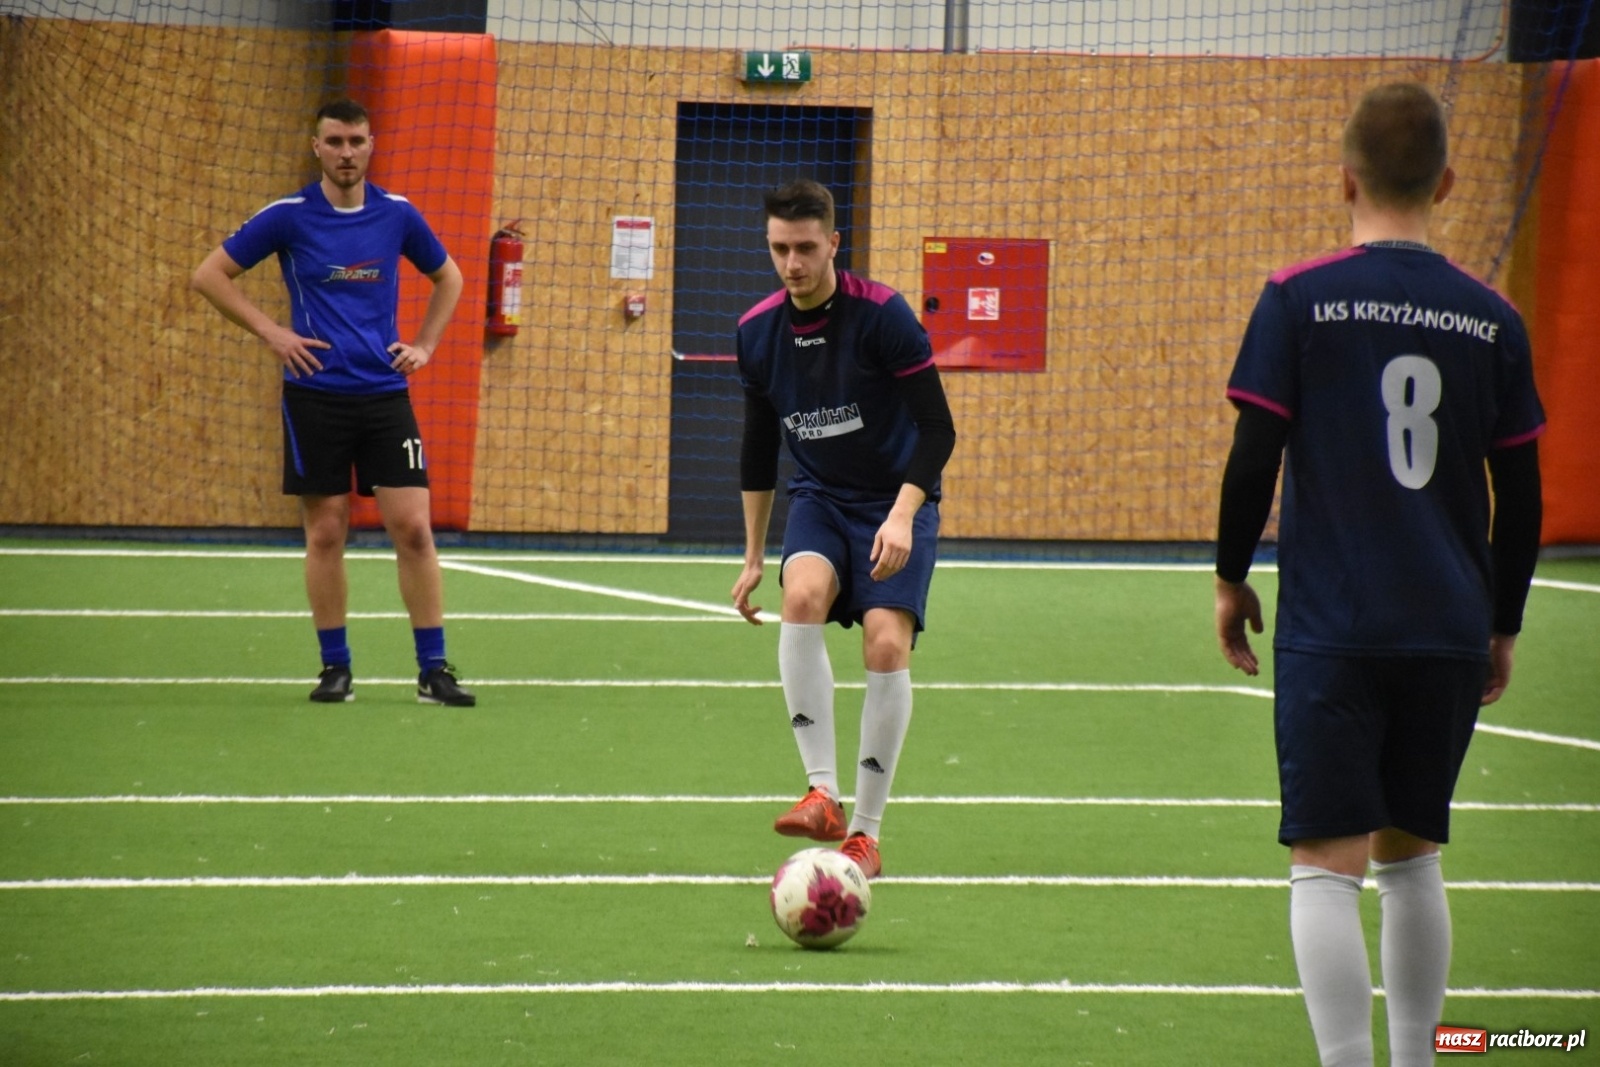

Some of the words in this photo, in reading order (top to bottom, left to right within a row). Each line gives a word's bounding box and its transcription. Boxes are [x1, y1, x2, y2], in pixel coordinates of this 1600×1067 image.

[1313, 301, 1349, 322] LKS
[1353, 301, 1499, 343] KRZYŻANOWICE
[1381, 355, 1442, 490] 8
[402, 438, 424, 469] 17
